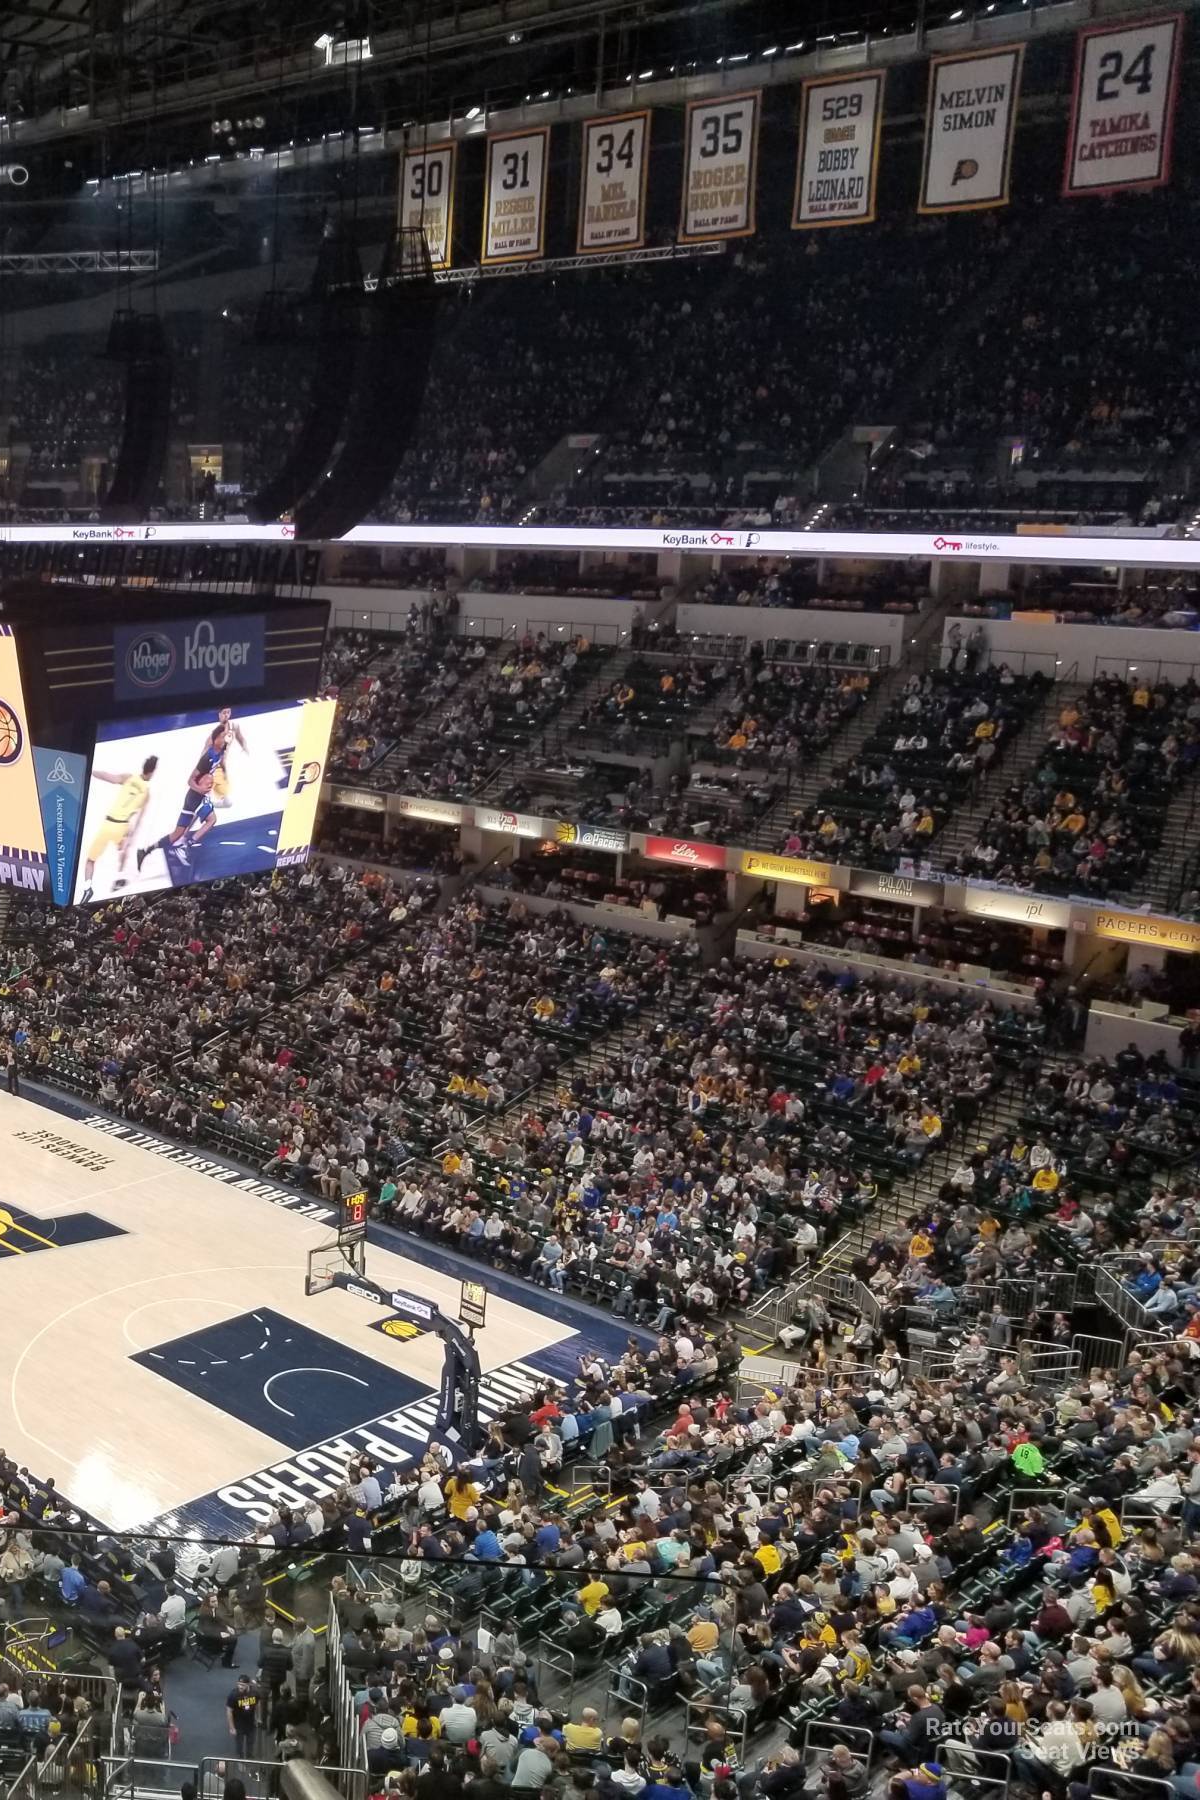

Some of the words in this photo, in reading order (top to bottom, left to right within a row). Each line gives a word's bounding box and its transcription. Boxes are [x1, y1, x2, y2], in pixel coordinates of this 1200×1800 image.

[1096, 43, 1155, 101] 24
[822, 94, 862, 121] 529
[939, 84, 1006, 110] MELVIN
[943, 108, 997, 132] SIMON
[1090, 113, 1150, 137] TAMIKA
[700, 111, 744, 158] 35
[1078, 133, 1157, 161] CATCHINGS
[596, 129, 635, 173] 34
[817, 147, 860, 173] BOBBY
[411, 160, 443, 199] 30
[502, 151, 530, 190] 31
[691, 164, 747, 189] ROGER
[689, 189, 746, 212] BROWN
[807, 177, 864, 202] LEONARD
[491, 213, 536, 237] MILLER
[72, 529, 112, 541] KeyBank
[663, 534, 708, 547] KeyBank
[133, 642, 170, 679] Kroger
[184, 621, 251, 688] Kroger
[56, 794, 65, 847] Ascension
[56, 849, 65, 858] St.
[582, 832, 625, 850] @Pacers
[671, 843, 699, 861] Lilly
[276, 853, 306, 867] REPLAY
[56, 859, 65, 892] Vincent
[1025, 902, 1042, 918] ipl
[12, 1131, 43, 1144] LIFE
[78, 1114, 131, 1136] HERE
[32, 1129, 116, 1164] FIELDHOUSE
[40, 1143, 106, 1172] BANKERS
[122, 1132, 240, 1181] BASKETBALL
[231, 1177, 299, 1208] GROW
[291, 1203, 335, 1221] WE
[354, 1204, 362, 1220] 8
[347, 1283, 381, 1304] GEICO
[217, 1428, 413, 1523] PACERS
